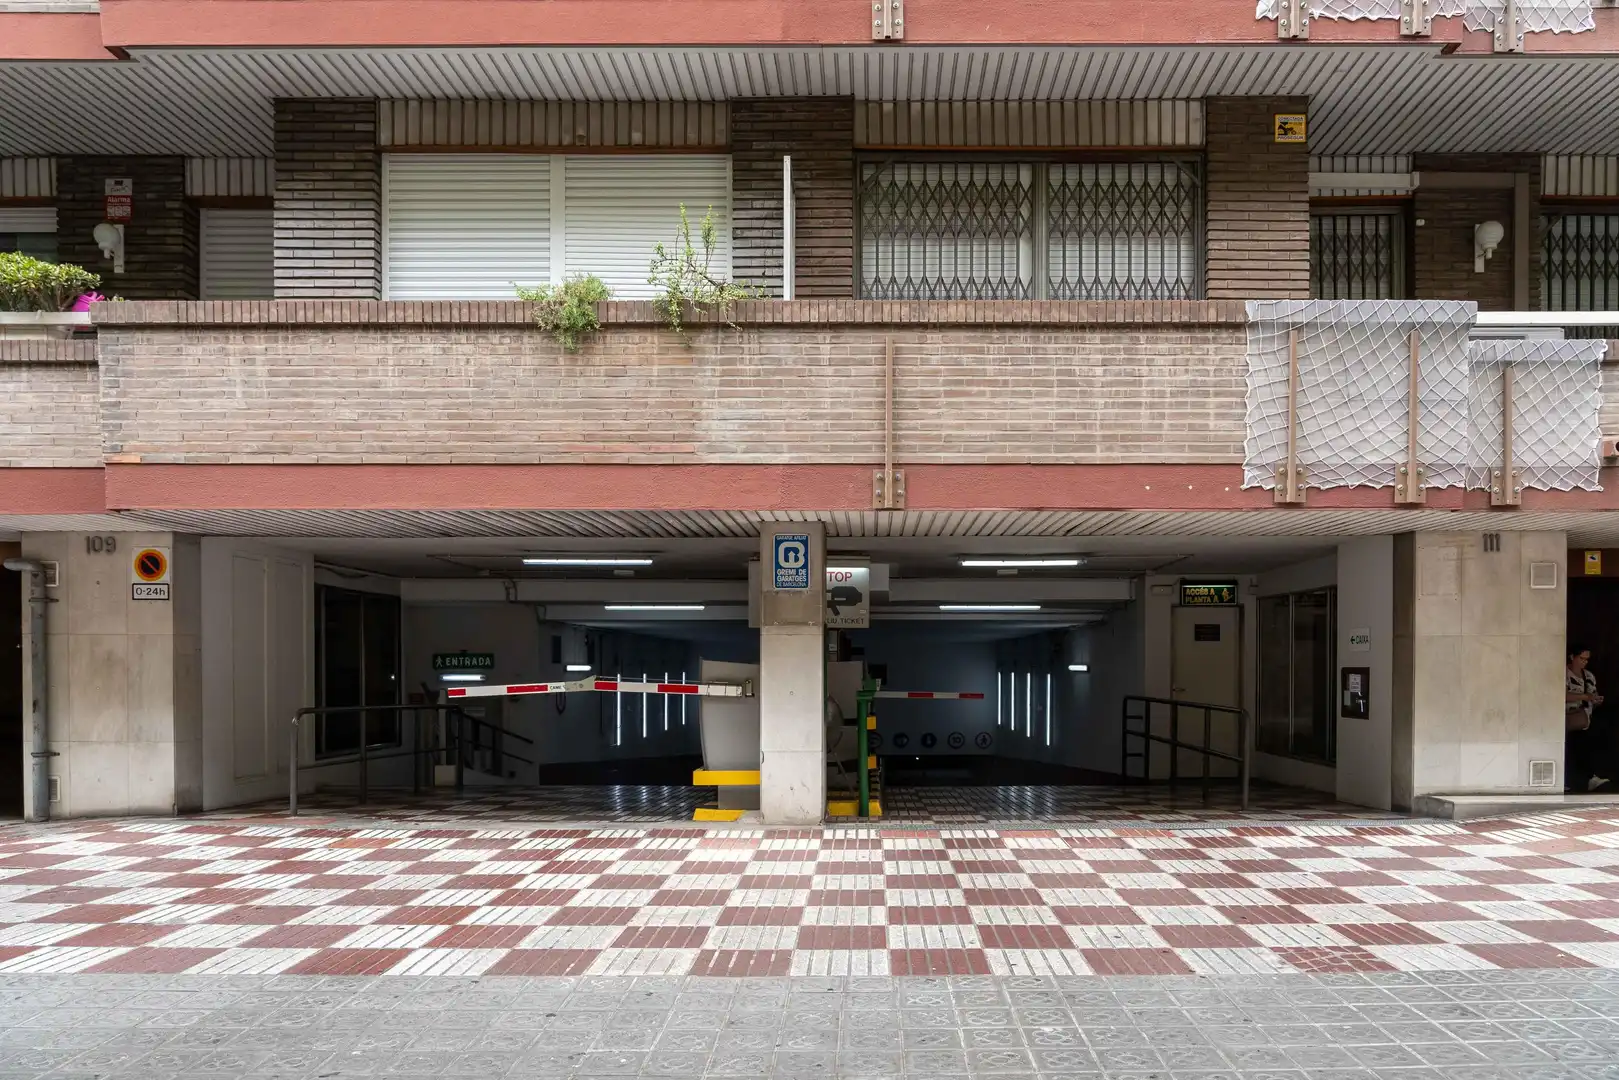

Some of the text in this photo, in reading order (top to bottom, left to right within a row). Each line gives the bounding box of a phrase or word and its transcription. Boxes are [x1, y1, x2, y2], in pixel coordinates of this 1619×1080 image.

[85, 535, 117, 555] 109
[1482, 533, 1501, 552] 111
[826, 571, 852, 582] TOP
[135, 587, 166, 596] 0-24h
[445, 656, 492, 667] ENTRADA
